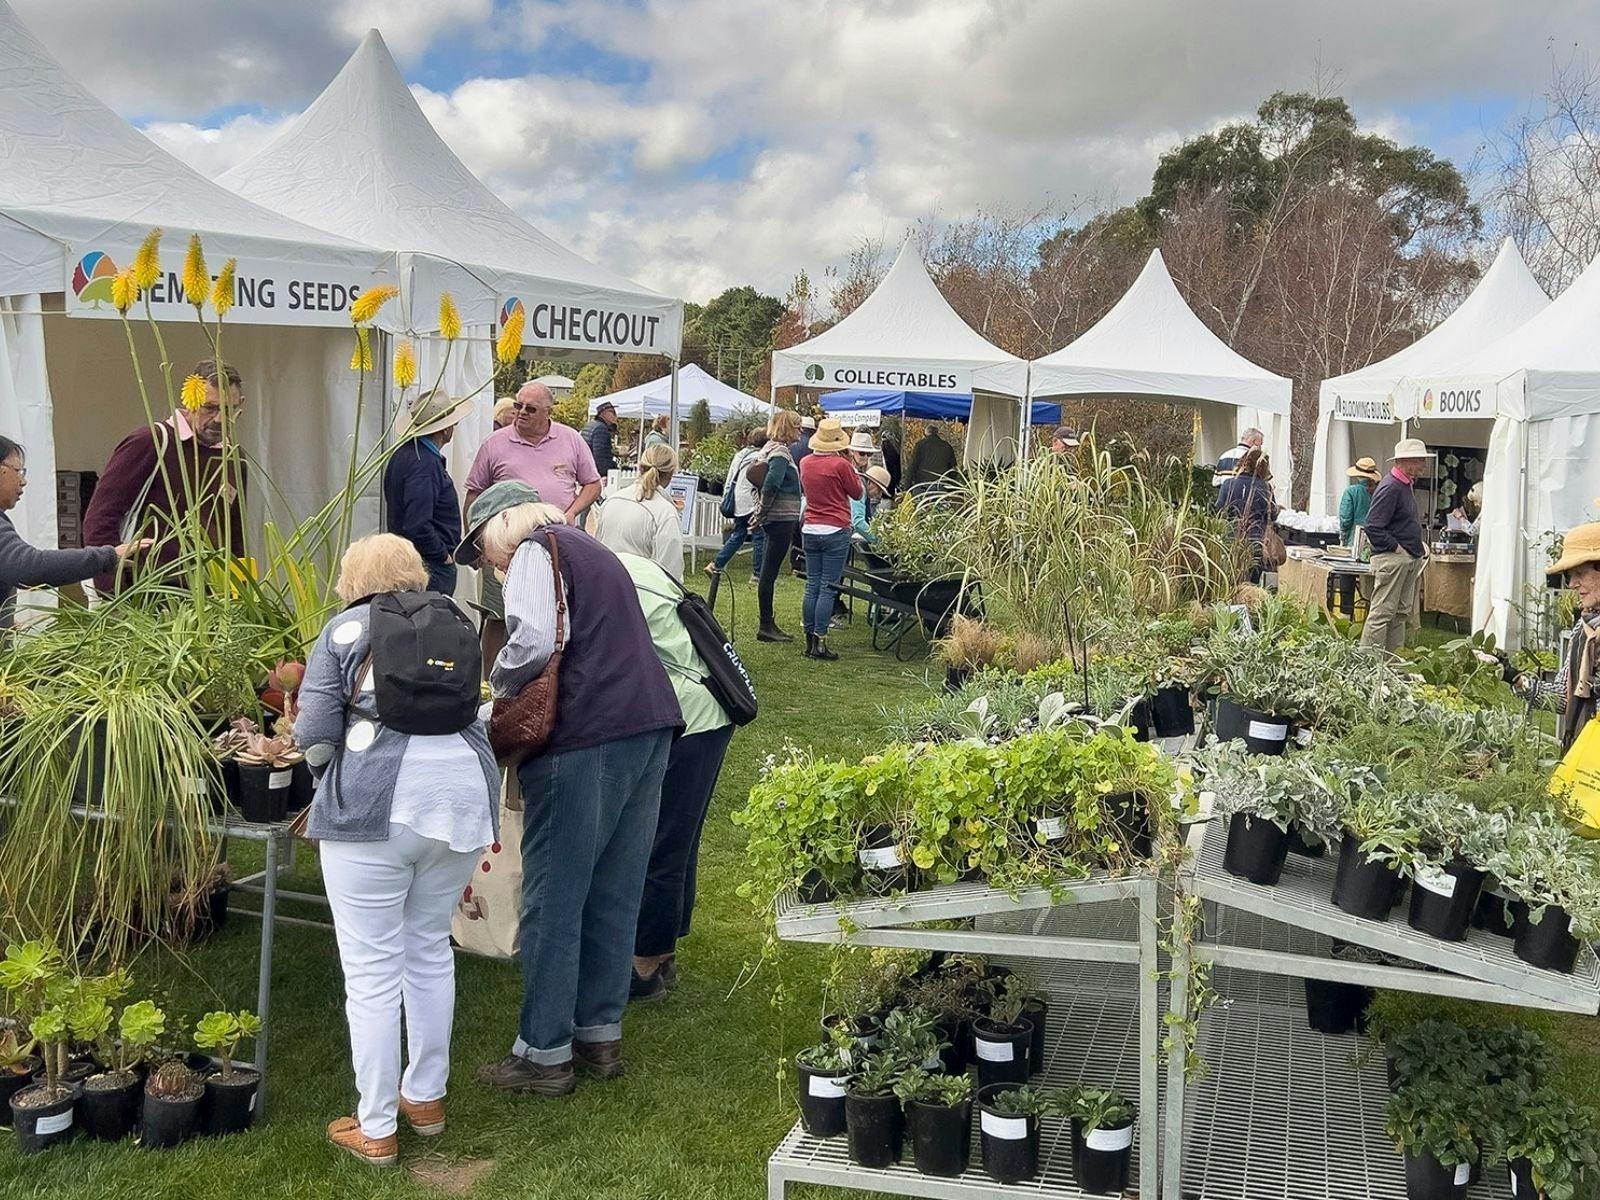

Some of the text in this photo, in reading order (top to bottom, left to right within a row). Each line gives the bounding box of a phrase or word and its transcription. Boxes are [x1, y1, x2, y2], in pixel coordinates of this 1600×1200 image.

[135, 271, 361, 311] EMNG SEEDS
[532, 303, 660, 347] CHECKOUT
[834, 369, 957, 389] COLLECTABLES
[1439, 389, 1482, 413] BOOKS
